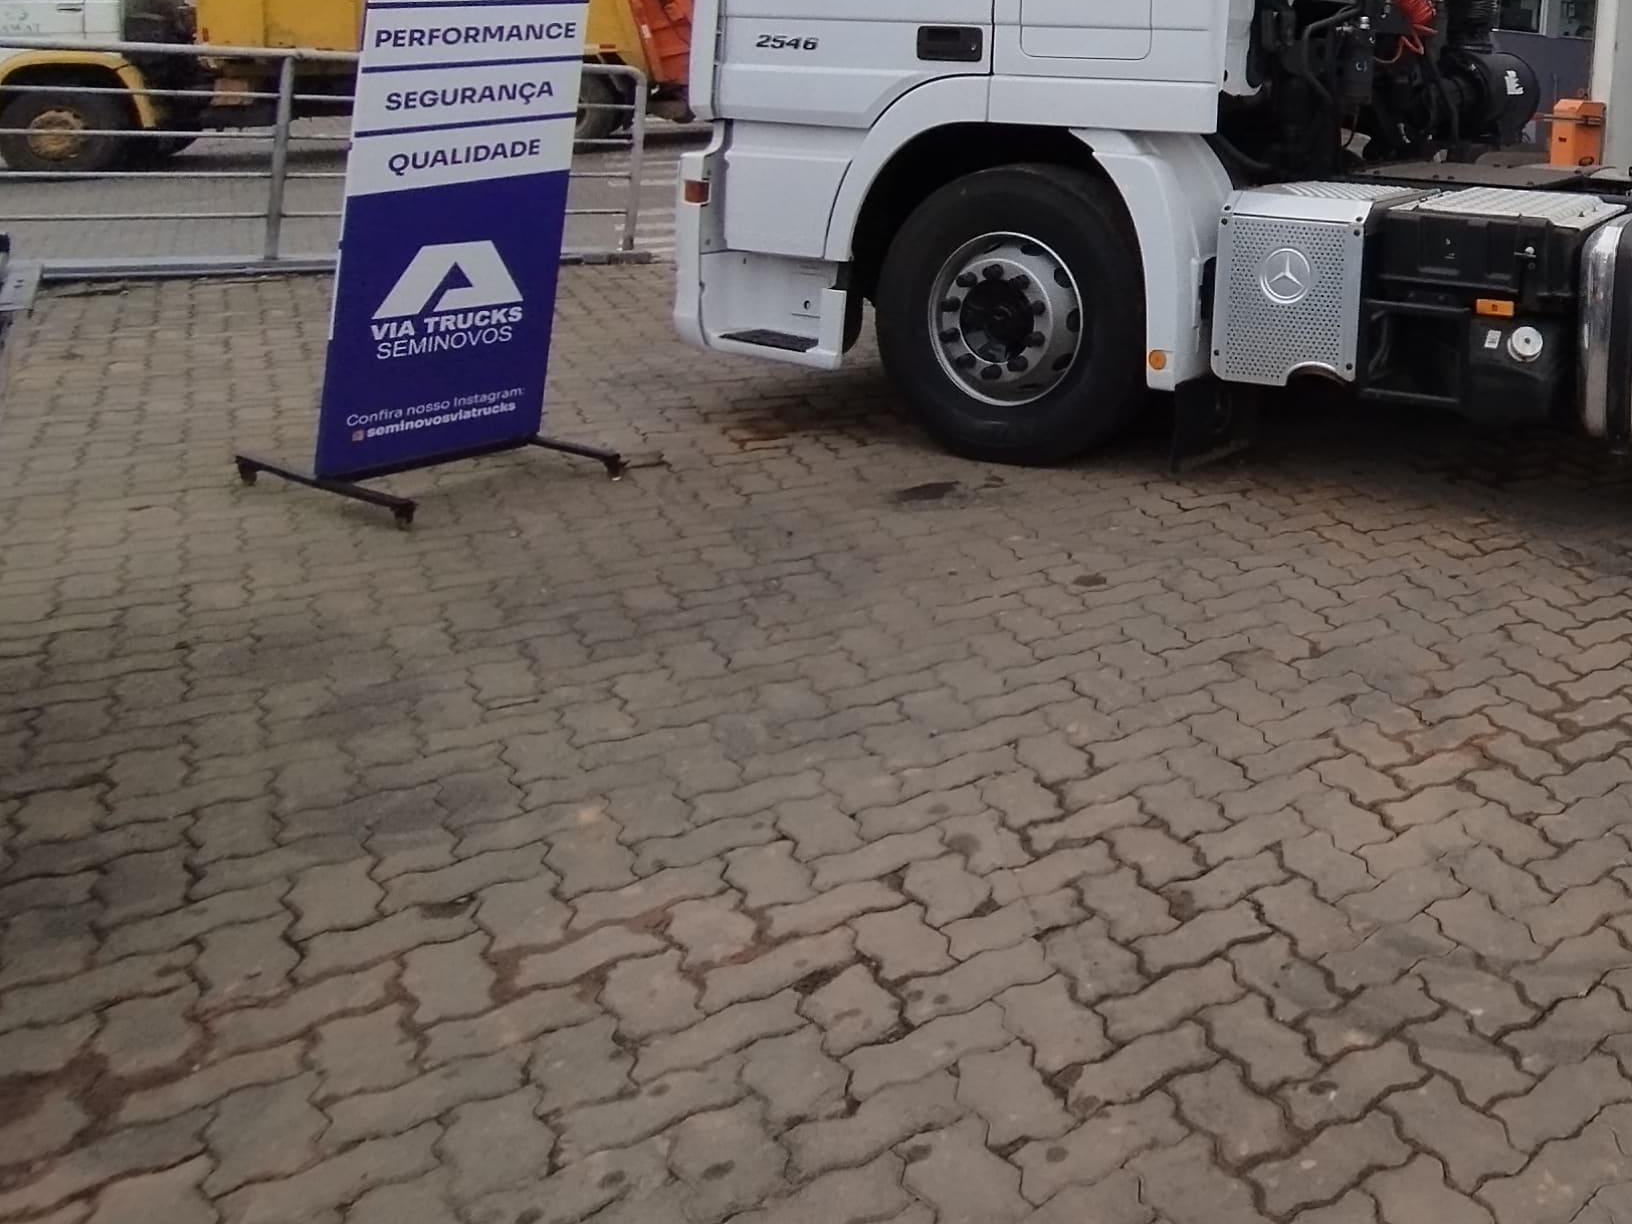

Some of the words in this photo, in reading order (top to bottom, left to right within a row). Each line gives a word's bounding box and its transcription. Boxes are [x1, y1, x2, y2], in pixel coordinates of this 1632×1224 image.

[375, 22, 576, 48] PERFORMANCE
[756, 34, 819, 51] 2546
[385, 80, 554, 111] SEGURANÇA
[388, 139, 541, 175] QUALIDADE
[371, 321, 415, 341] VIA
[424, 306, 523, 333] TRUCKS
[376, 325, 513, 360] SEMINOVOS
[346, 409, 403, 427] Confira
[406, 400, 450, 415] nosso
[367, 402, 516, 438] seminovosviatrucks
